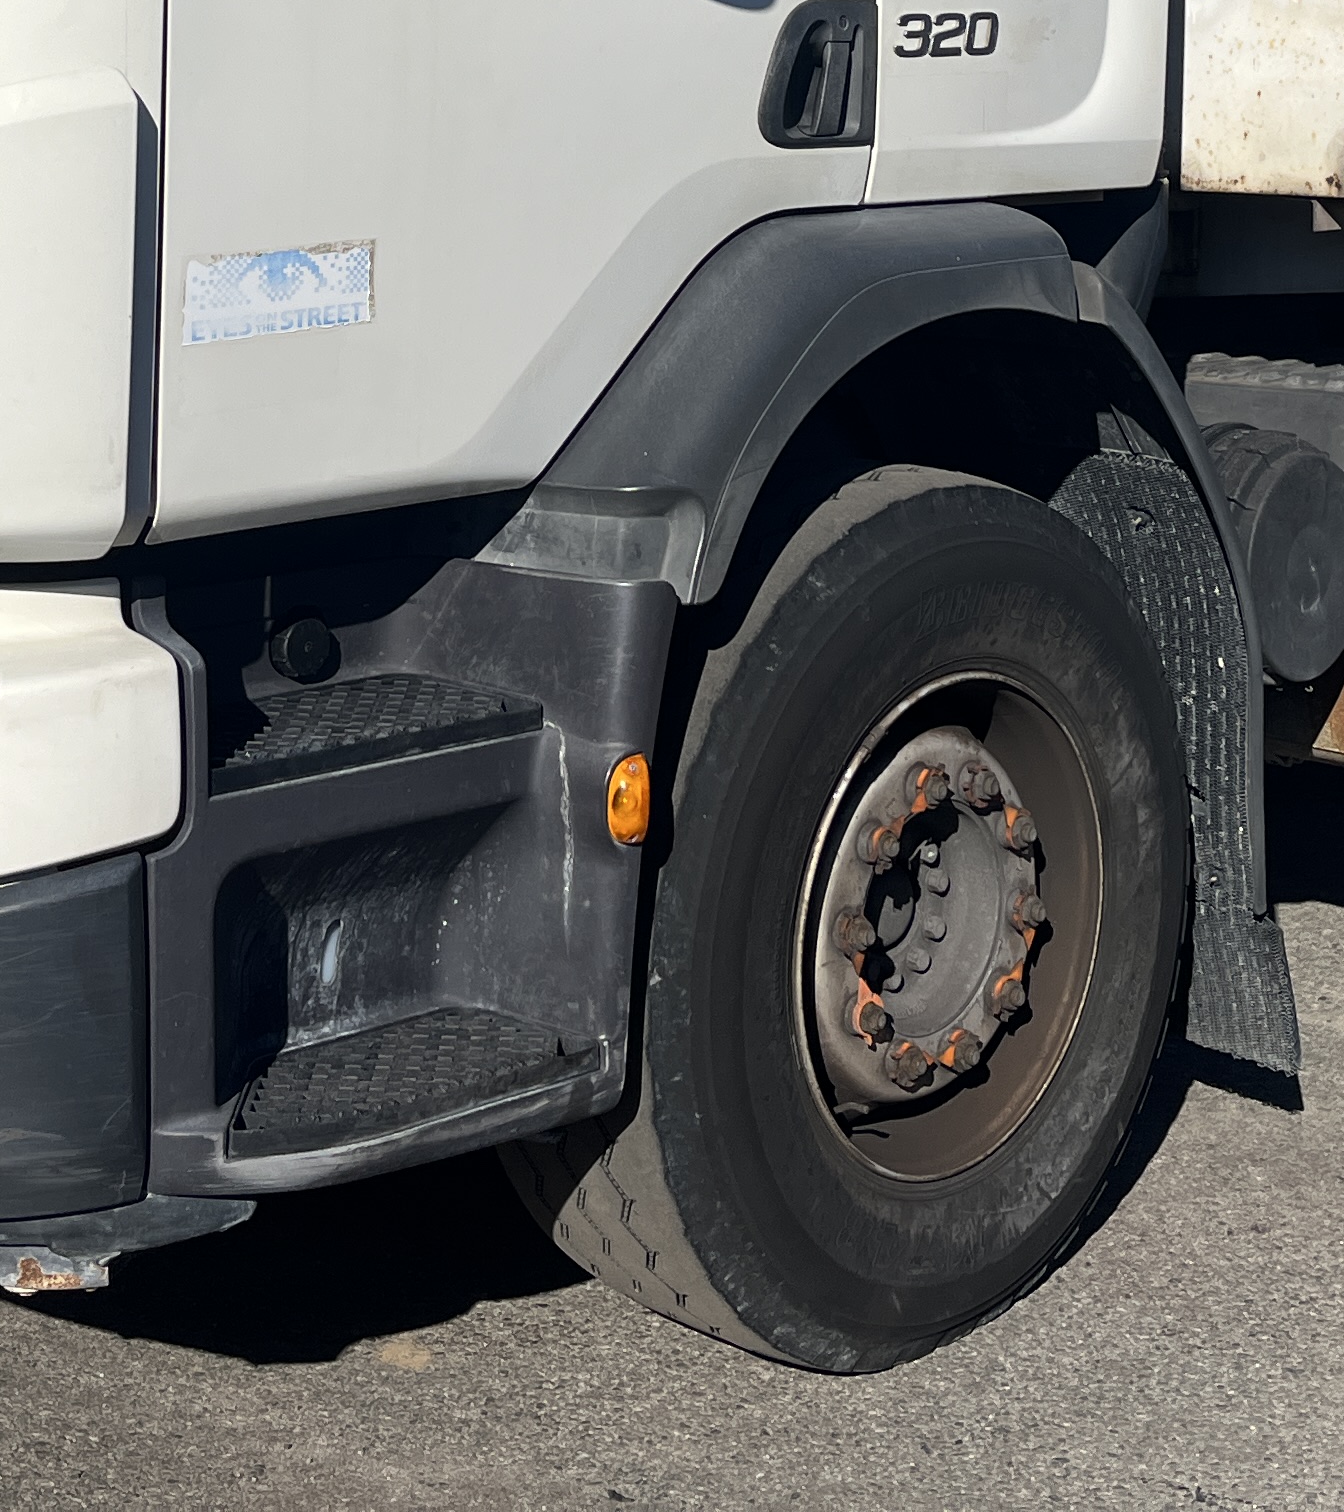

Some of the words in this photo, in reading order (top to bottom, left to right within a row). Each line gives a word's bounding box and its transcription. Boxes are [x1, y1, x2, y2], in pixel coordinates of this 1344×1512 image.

[893, 11, 999, 58] 320
[256, 321, 278, 334] THE
[280, 302, 366, 330] STREET
